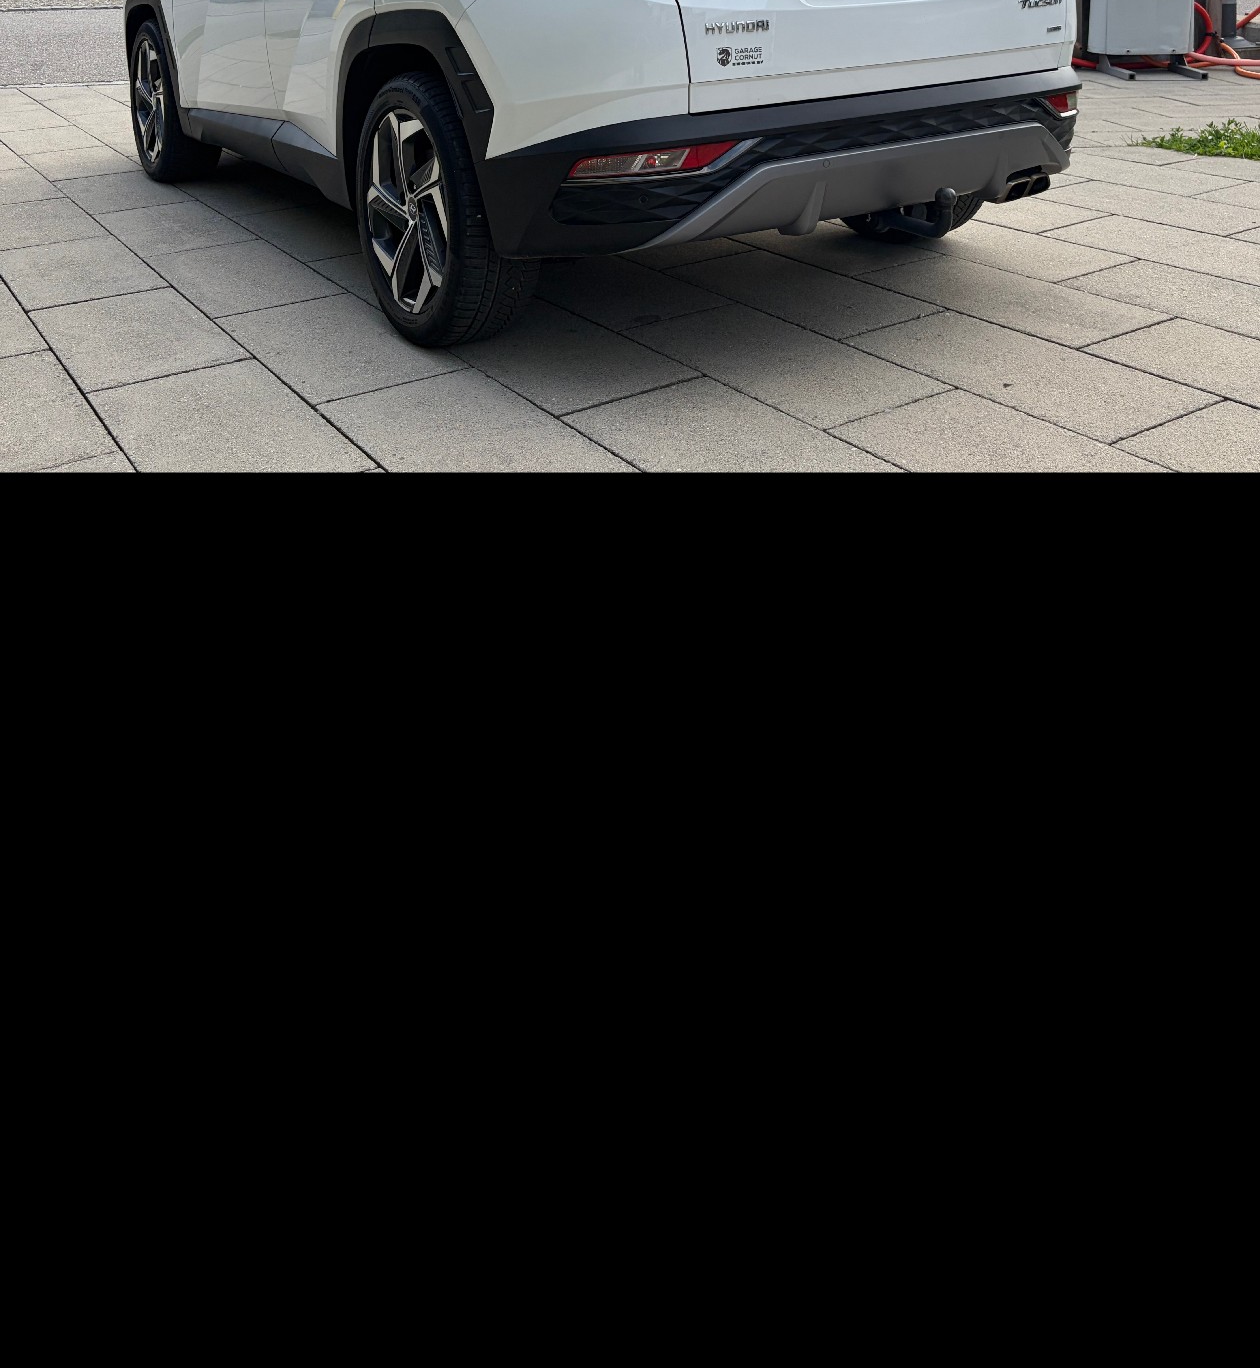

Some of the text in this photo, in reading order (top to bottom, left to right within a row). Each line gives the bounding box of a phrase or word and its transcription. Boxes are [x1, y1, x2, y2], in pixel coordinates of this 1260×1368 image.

[705, 19, 769, 35] HYUNDAI
[734, 46, 763, 54] GARAGE
[734, 53, 763, 61] CORNUT
